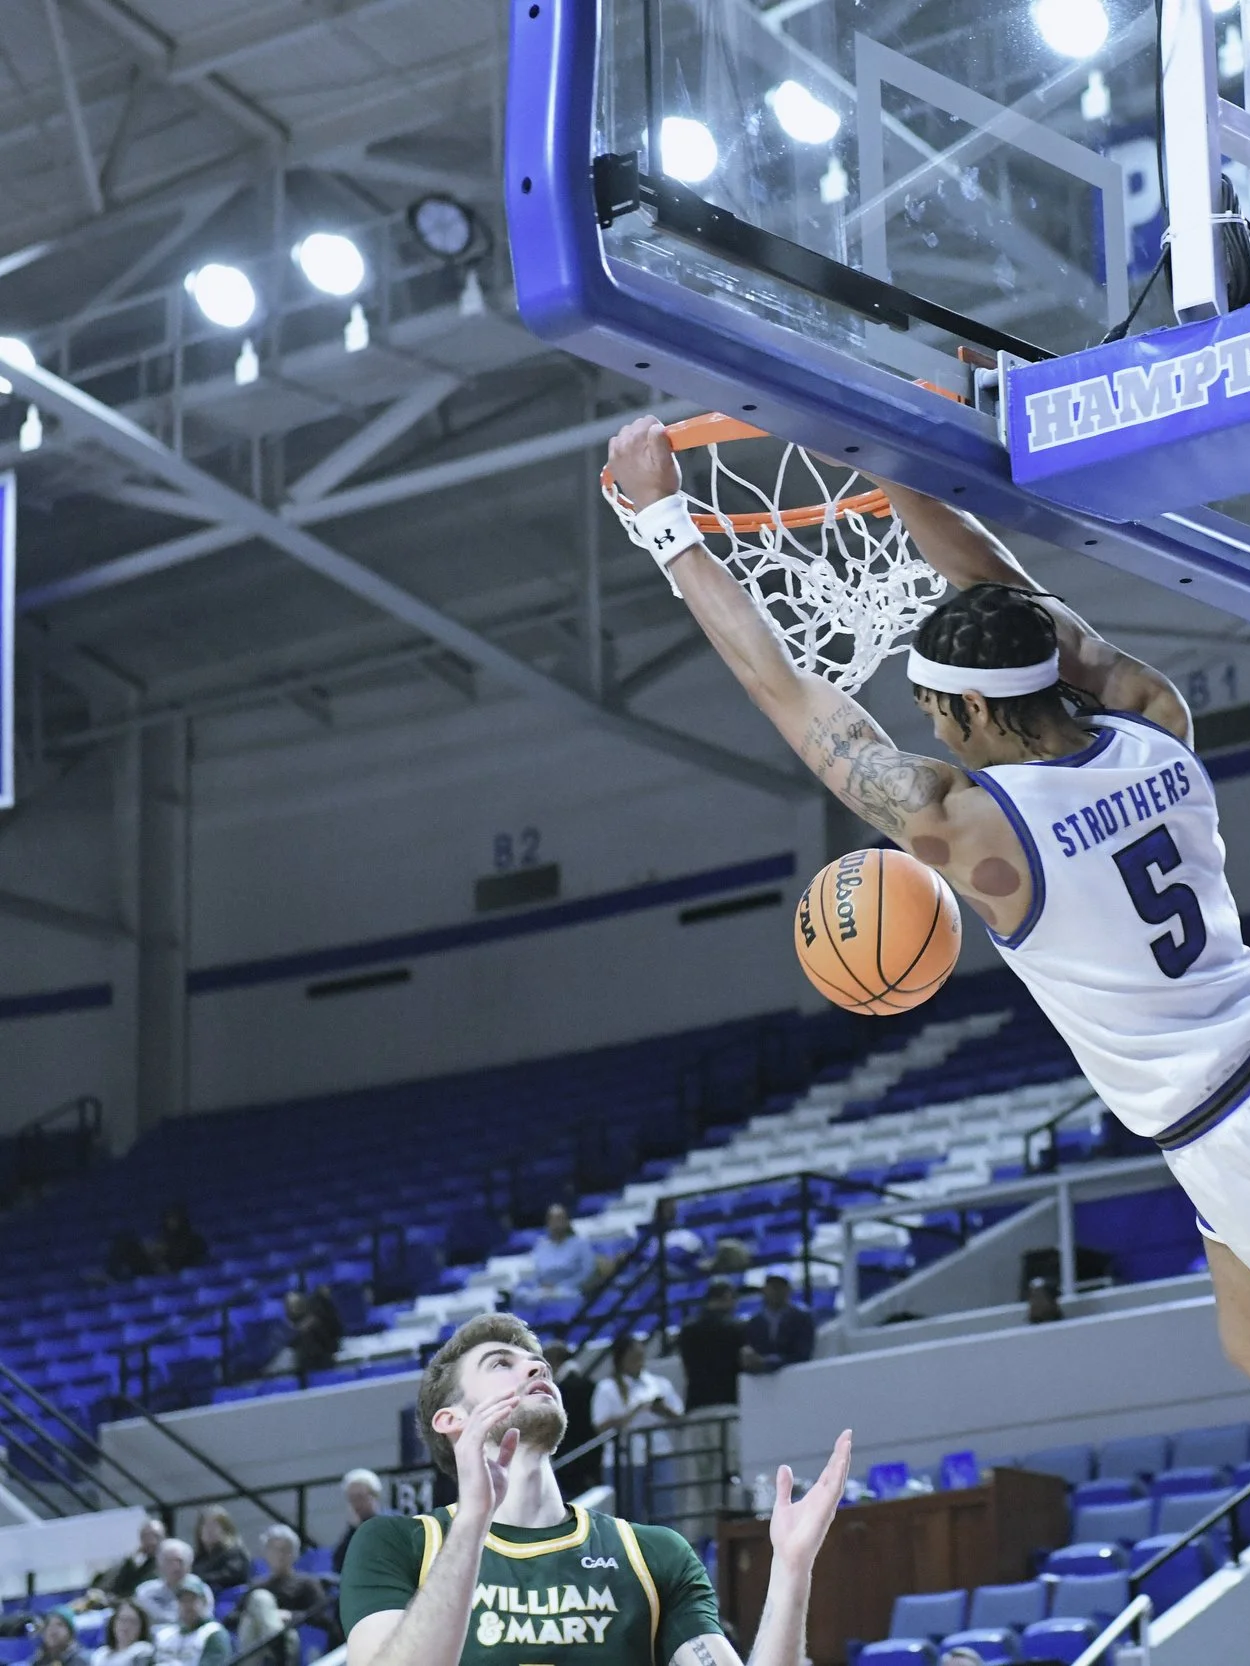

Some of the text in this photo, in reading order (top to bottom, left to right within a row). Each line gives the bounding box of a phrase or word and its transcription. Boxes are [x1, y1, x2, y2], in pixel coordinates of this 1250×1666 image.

[1052, 761, 1191, 858] STROTHERS
[836, 850, 869, 942] Wilson
[1111, 823, 1207, 979] 5
[471, 1582, 619, 1615] WILLIAM
[581, 1556, 619, 1569] CAA
